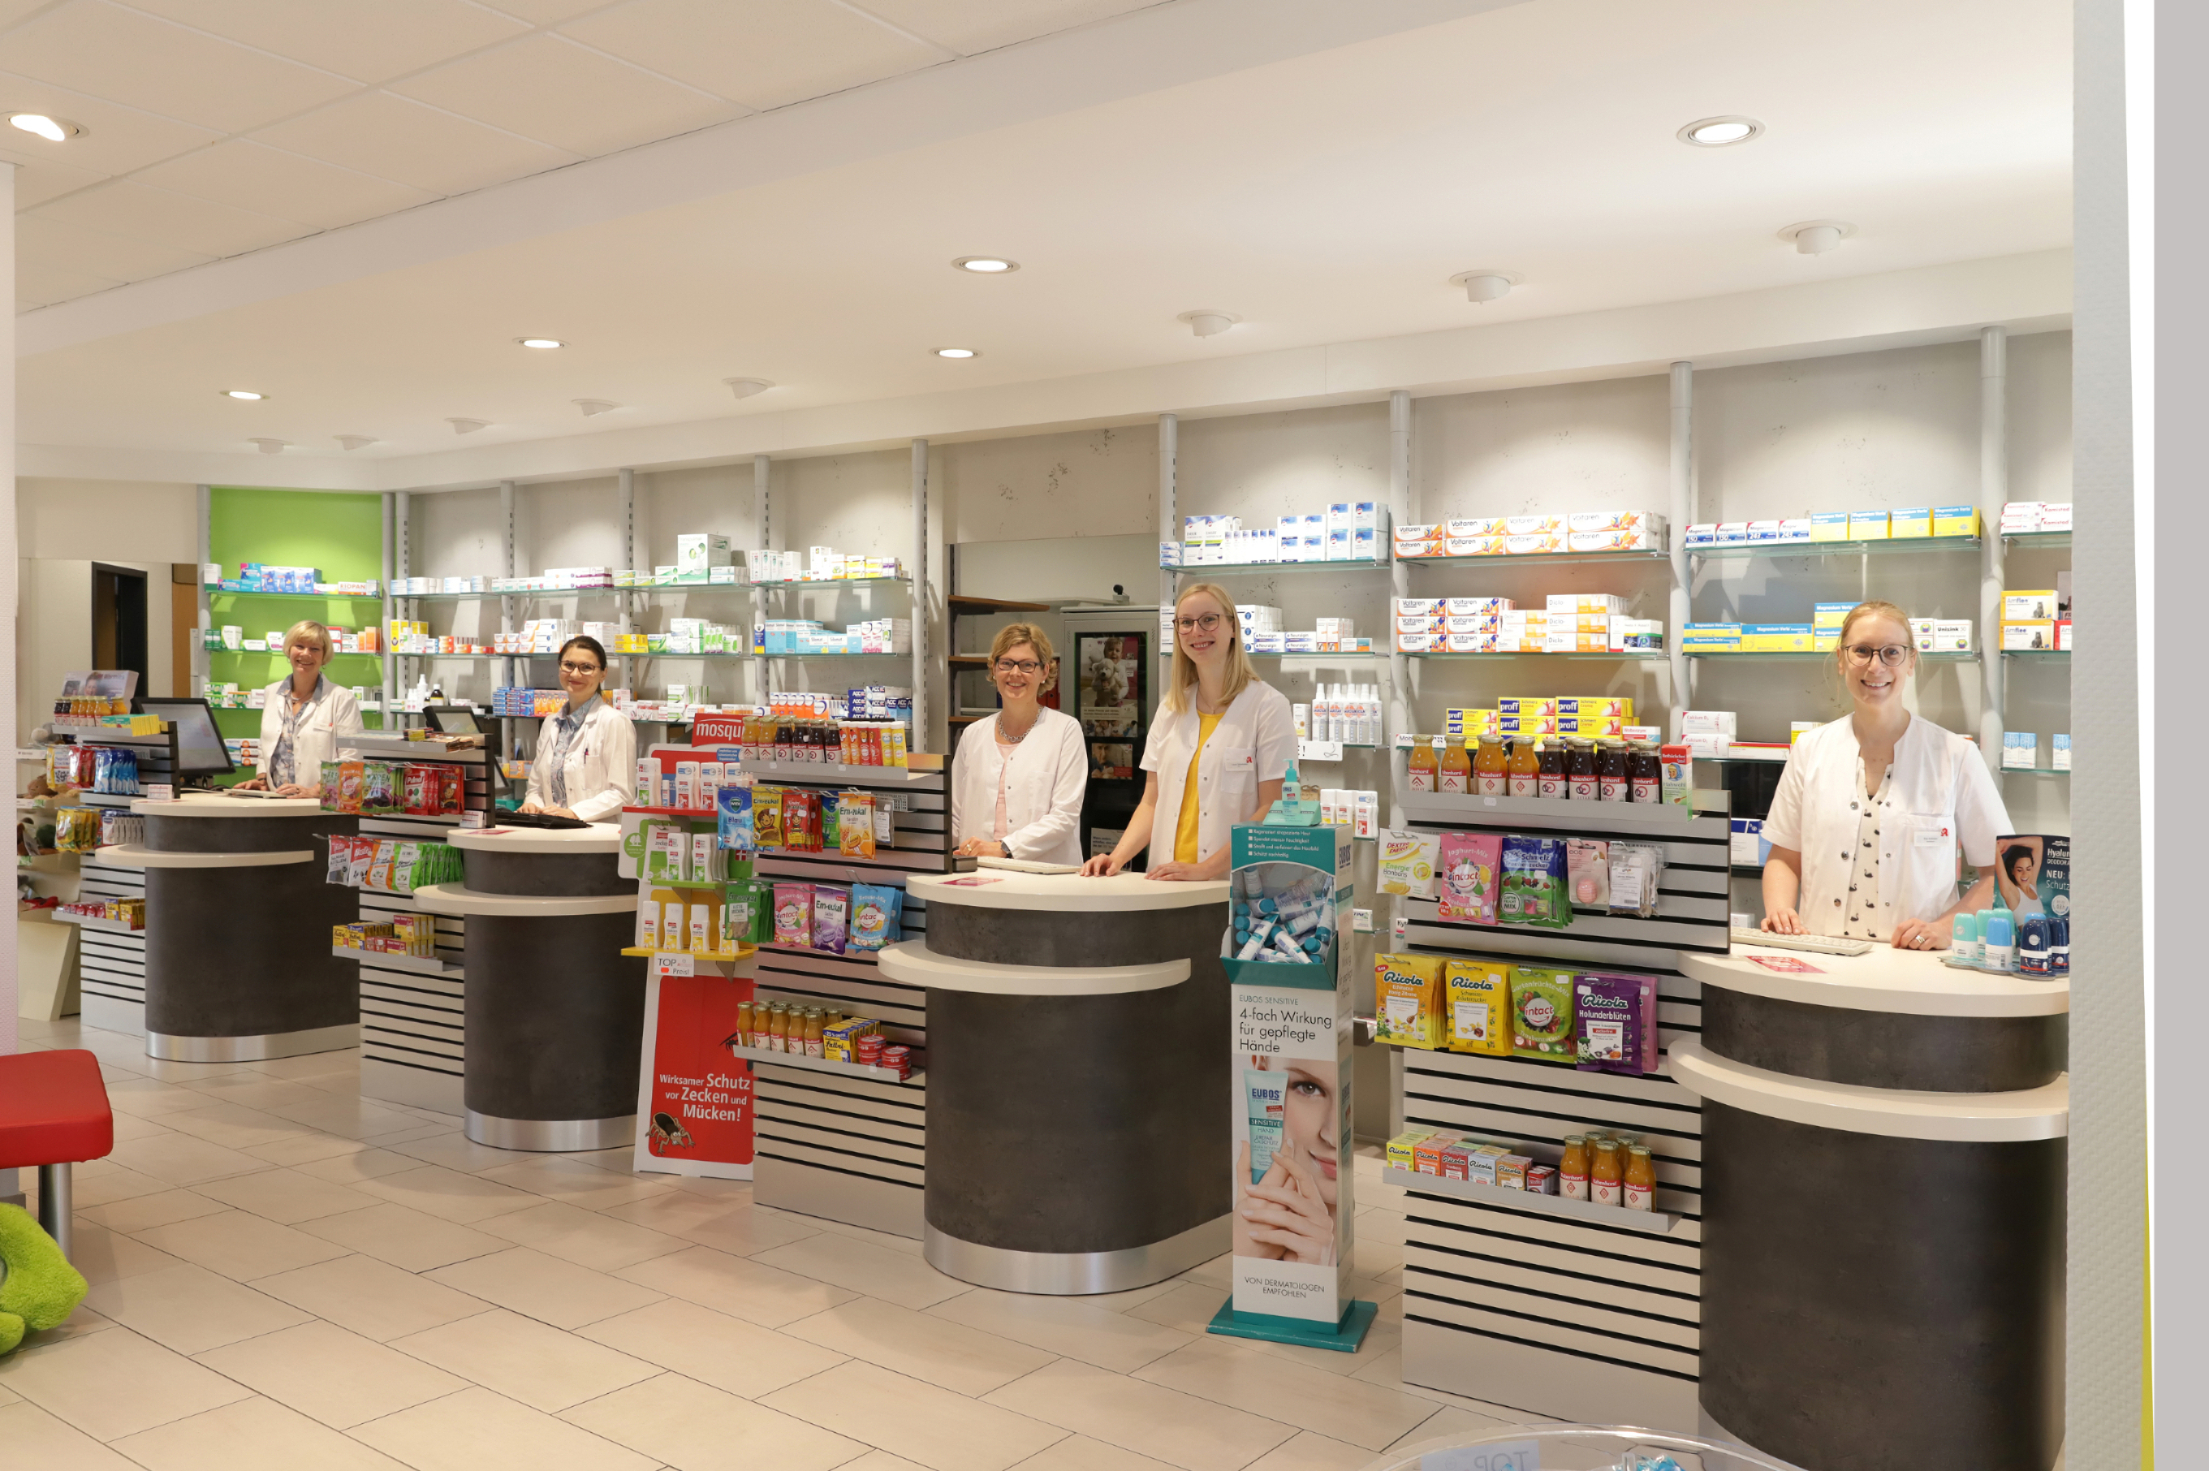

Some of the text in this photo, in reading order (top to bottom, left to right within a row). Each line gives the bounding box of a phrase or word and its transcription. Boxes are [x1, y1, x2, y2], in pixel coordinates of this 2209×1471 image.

[1573, 514, 1600, 522] Voltaren
[1451, 520, 1478, 528] Voltaren
[1450, 538, 1476, 546] Voltaren
[1500, 701, 1519, 712] proff
[1558, 701, 1578, 712] proff
[1448, 724, 1463, 732] proff
[1500, 718, 1519, 730] proff
[1558, 720, 1578, 730] proff
[1448, 848, 1489, 858] Joghurt-Mix
[1522, 853, 1550, 861] Schmelz
[1386, 863, 1410, 872] Energie
[1452, 872, 1479, 881] intact
[816, 901, 843, 912] Em-eukal
[658, 958, 676, 967] TOP
[673, 968, 689, 976] Preis!
[1384, 971, 1424, 986] Ricola
[1451, 976, 1494, 991] Ricola
[1240, 995, 1298, 1006] EUBOS SENSITIVE
[1582, 994, 1628, 1009] Ricola
[1525, 1006, 1554, 1015] intact
[1579, 1010, 1631, 1020] Holunderblüten
[1240, 1007, 1332, 1030] 4-fach Wirkung
[1240, 1022, 1316, 1043] für gepflegte
[1240, 1038, 1280, 1052] Hände
[660, 1073, 750, 1090] Wirksamer Schutz
[665, 1087, 748, 1105] vor Zecken und
[1252, 1088, 1280, 1099] EUBOS
[683, 1104, 741, 1122] Mücken!
[1251, 1119, 1280, 1127] SENSITIVE
[1389, 1146, 1411, 1156] Ricola
[1416, 1151, 1438, 1160] Ricola
[1442, 1155, 1466, 1165] Ricola
[1470, 1160, 1492, 1170] Ricola
[1498, 1165, 1522, 1174] Ricola
[1244, 1277, 1325, 1293] VON DERMATOLOGEN
[1263, 1287, 1307, 1298] EMPFOHLEN
